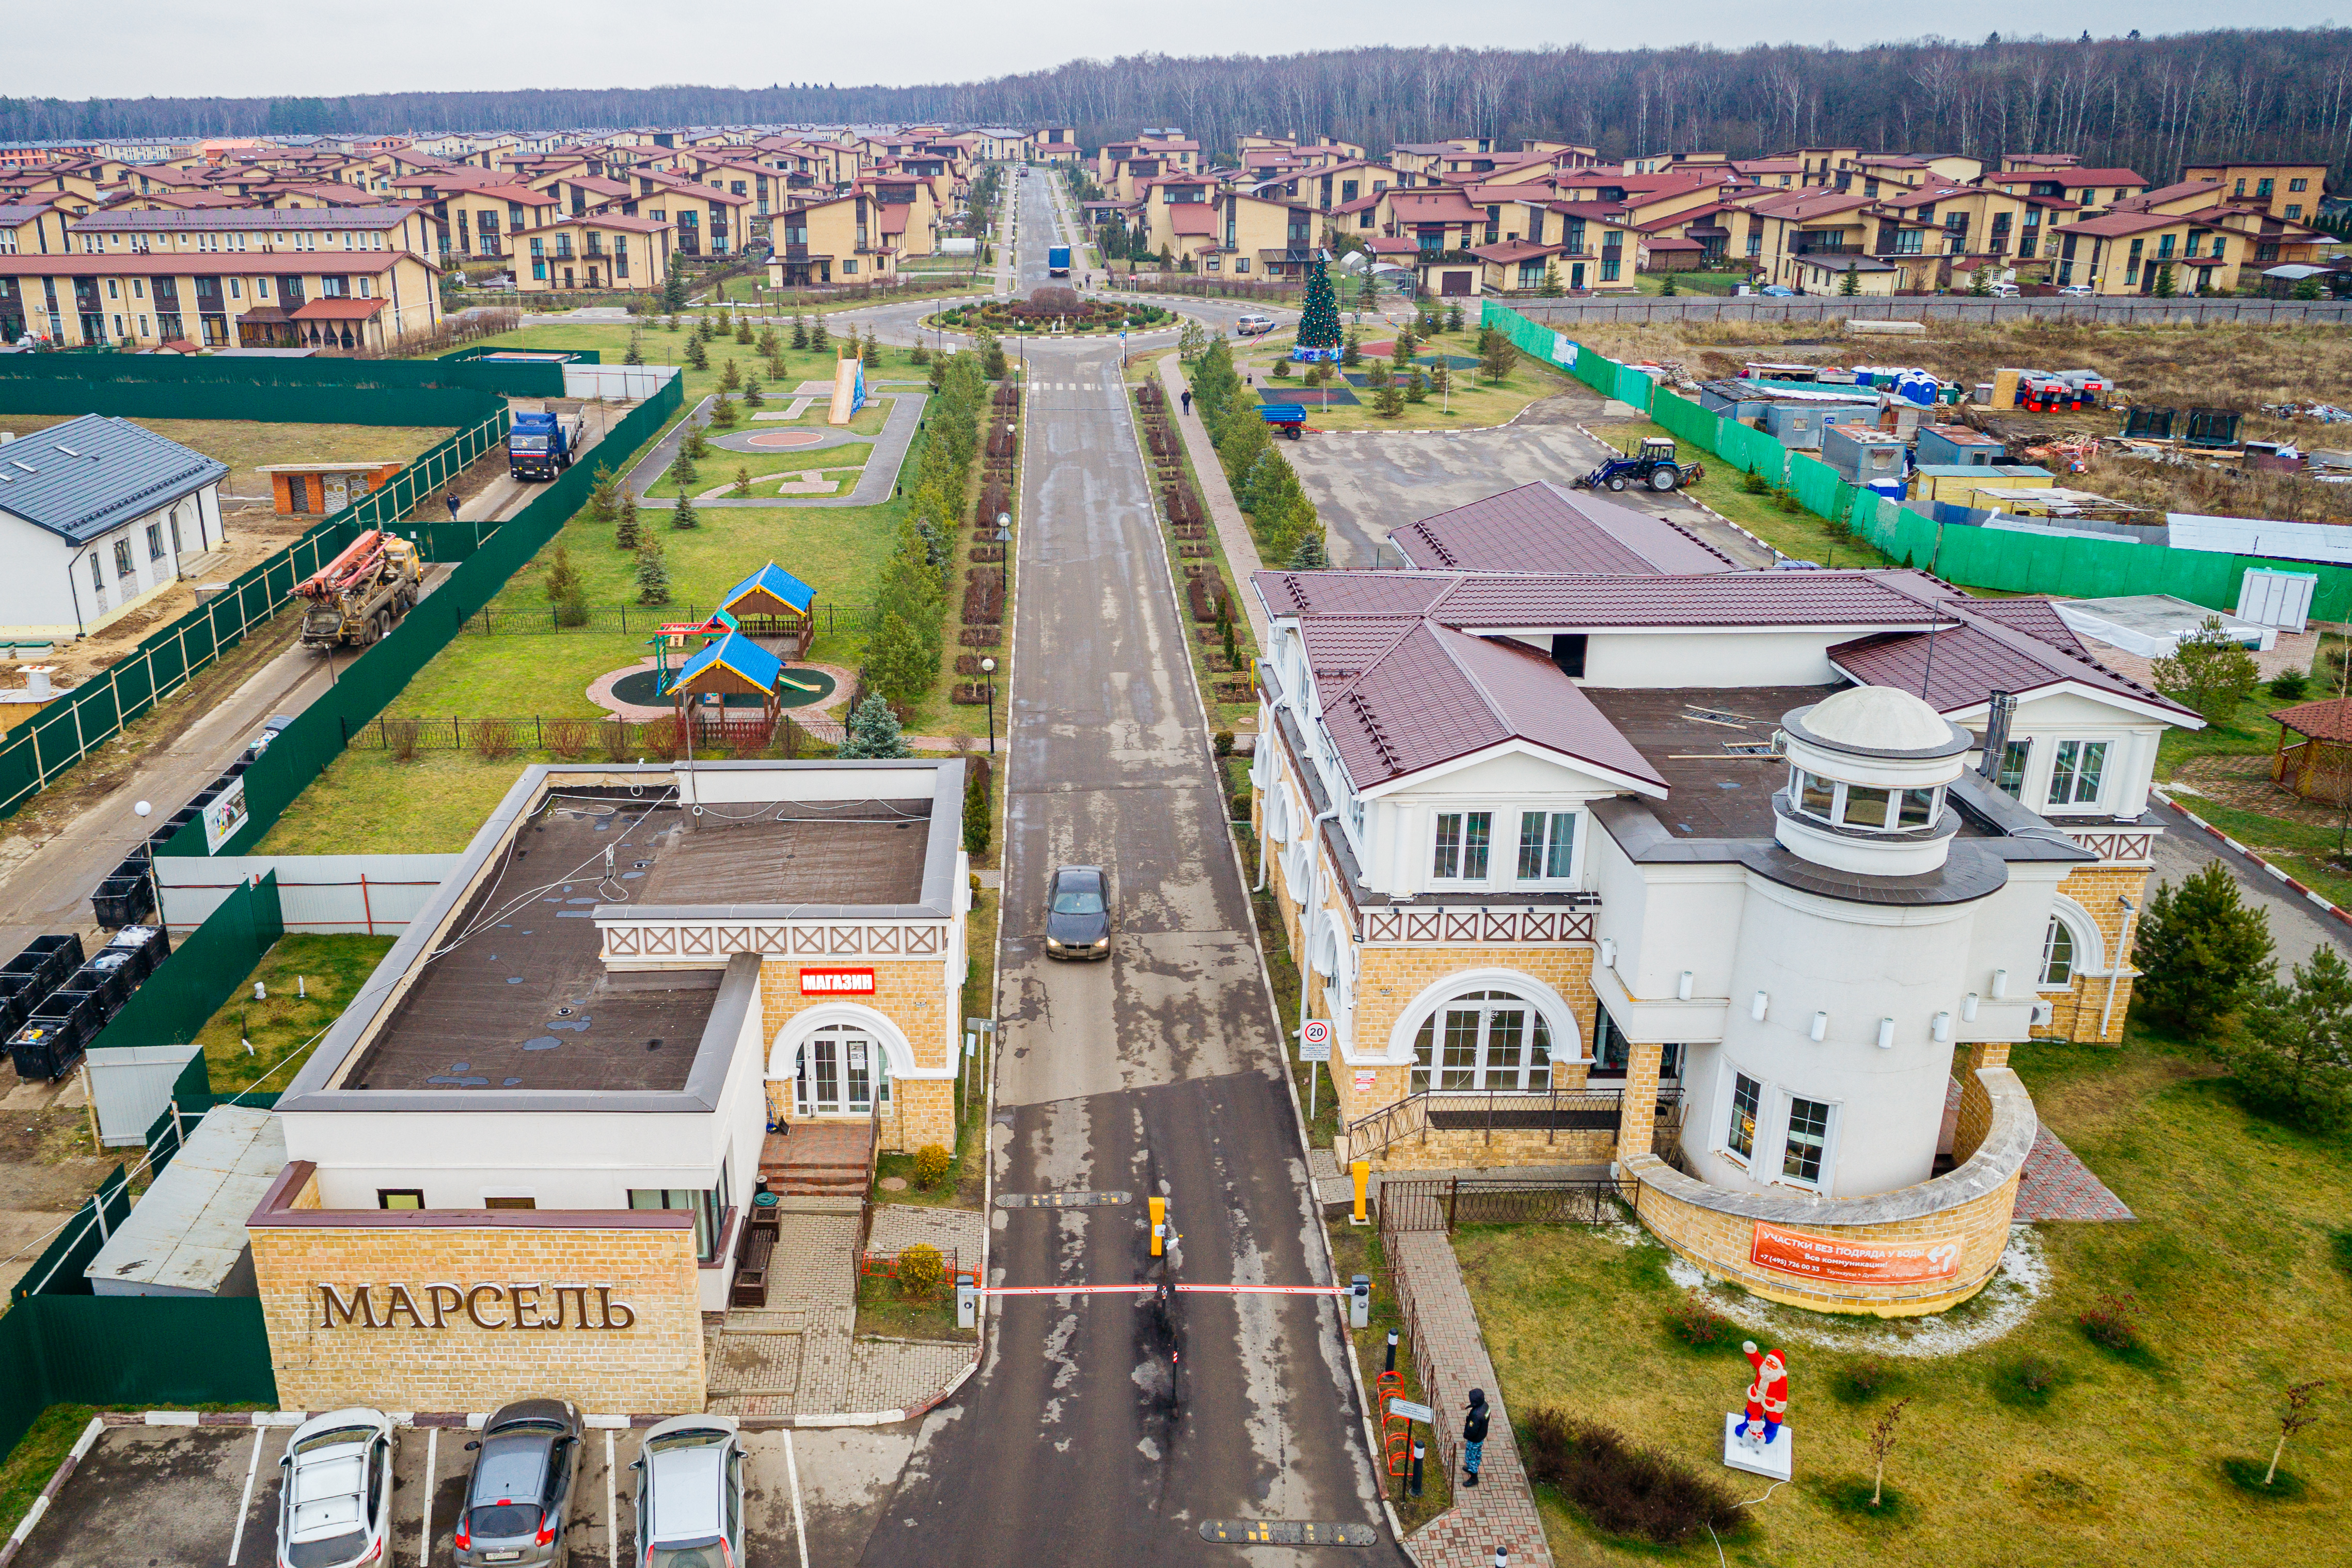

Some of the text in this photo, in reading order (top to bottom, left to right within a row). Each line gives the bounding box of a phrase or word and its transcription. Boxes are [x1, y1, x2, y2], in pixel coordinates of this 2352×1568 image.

[802, 974, 873, 990] МАГАЗИН
[1309, 1027, 1323, 1036] 20
[1763, 1231, 1813, 1250] УЧАСТКИ
[1815, 1244, 1834, 1254] БЕЗ
[1836, 1247, 1886, 1259] ПОДРЯДА
[1897, 1249, 1924, 1258] ВОДЫ
[1769, 1256, 1787, 1266] (495)
[1805, 1253, 1888, 1268] Все коммуникации!
[318, 1281, 636, 1330] МАРСЕЛЬ
